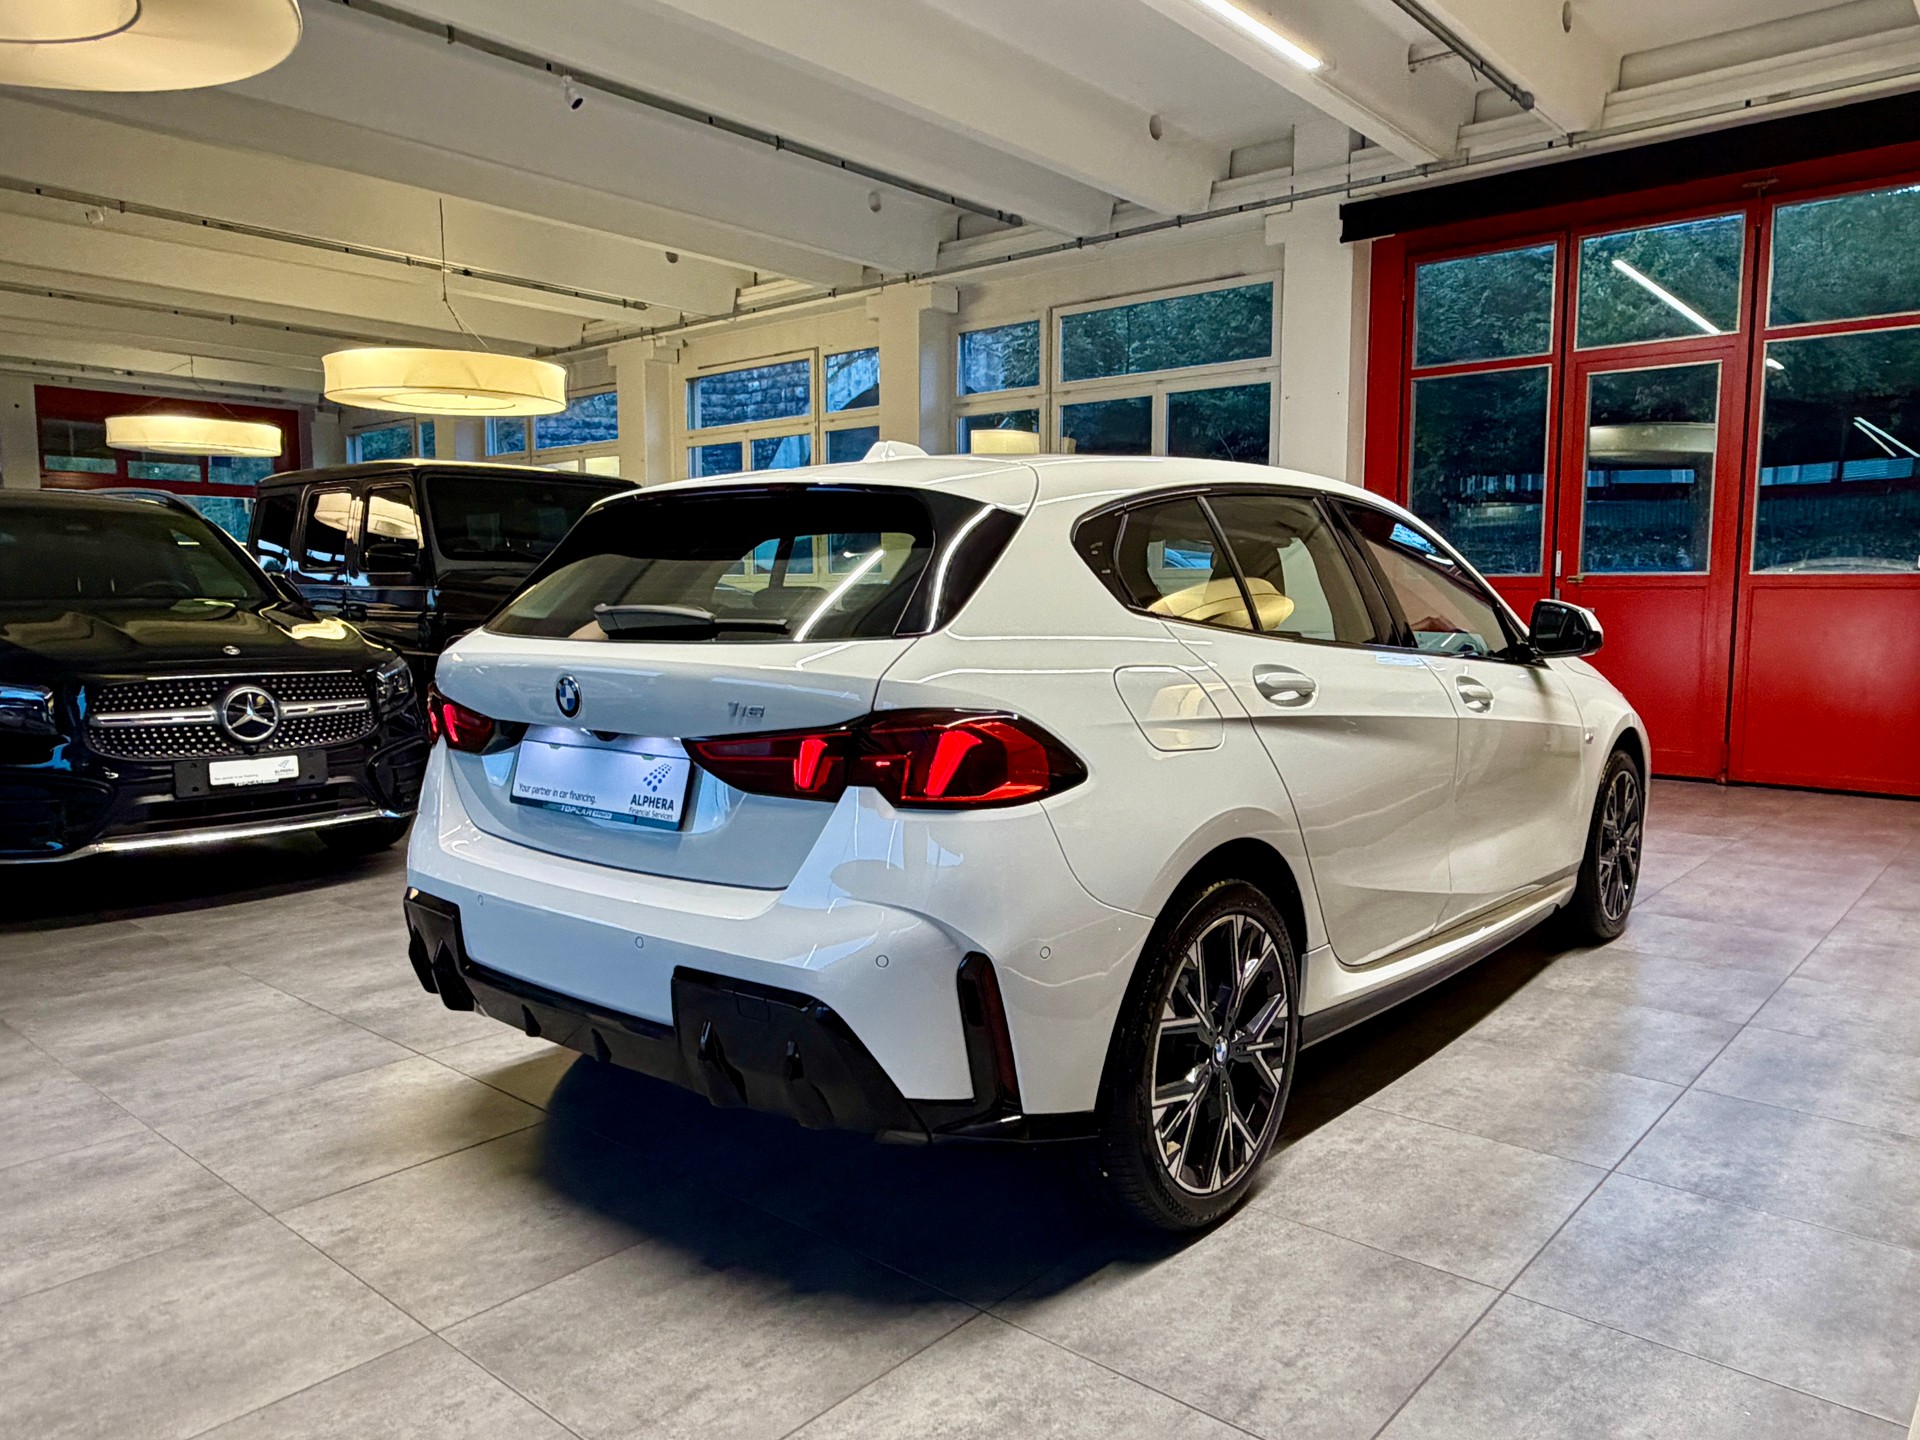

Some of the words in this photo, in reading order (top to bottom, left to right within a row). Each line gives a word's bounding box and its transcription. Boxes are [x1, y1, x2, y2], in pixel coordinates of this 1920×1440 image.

[519, 782, 531, 793] Your
[531, 786, 552, 797] partner
[553, 788, 559, 797] in
[559, 790, 569, 799] car
[569, 790, 597, 805] financing.
[630, 794, 674, 811] ALPHERA
[629, 806, 651, 817] Financial
[652, 809, 673, 820] Services
